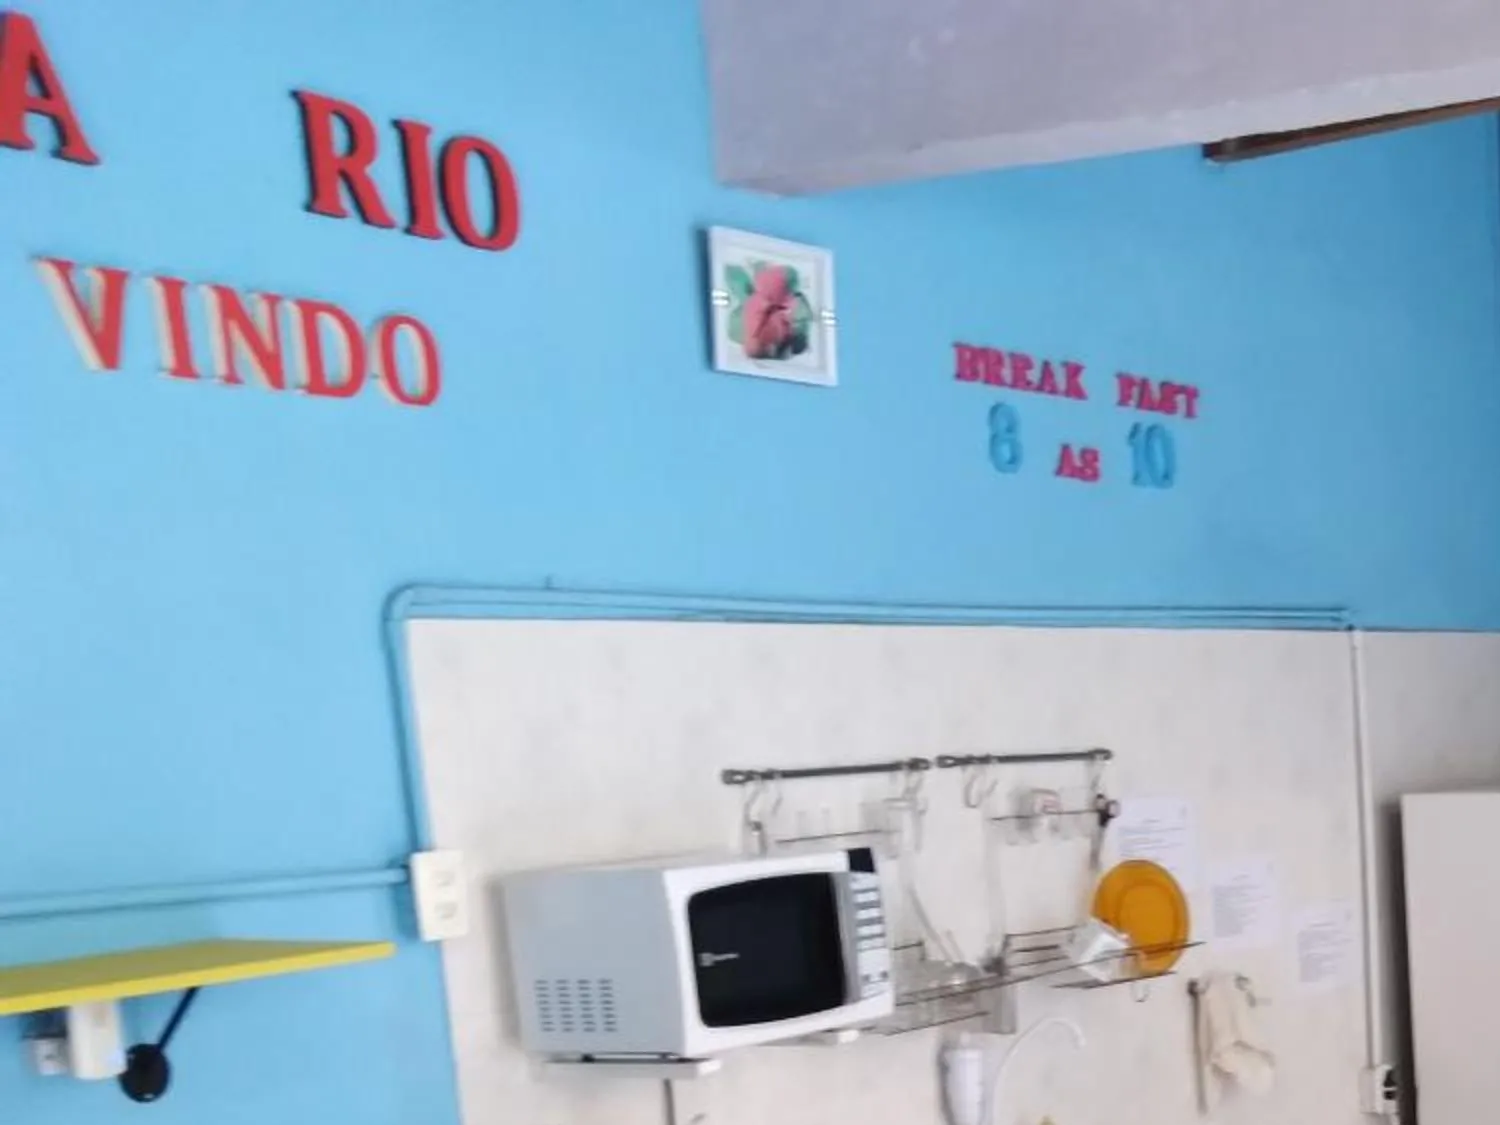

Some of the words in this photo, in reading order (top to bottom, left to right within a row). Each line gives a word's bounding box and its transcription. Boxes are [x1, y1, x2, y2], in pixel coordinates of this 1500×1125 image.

[288, 87, 522, 252] RIO
[35, 255, 443, 407] VINDO
[952, 341, 1088, 400] BREAK
[988, 402, 1023, 474] 8
[1054, 442, 1101, 483] AS
[1127, 422, 1177, 489] 10
